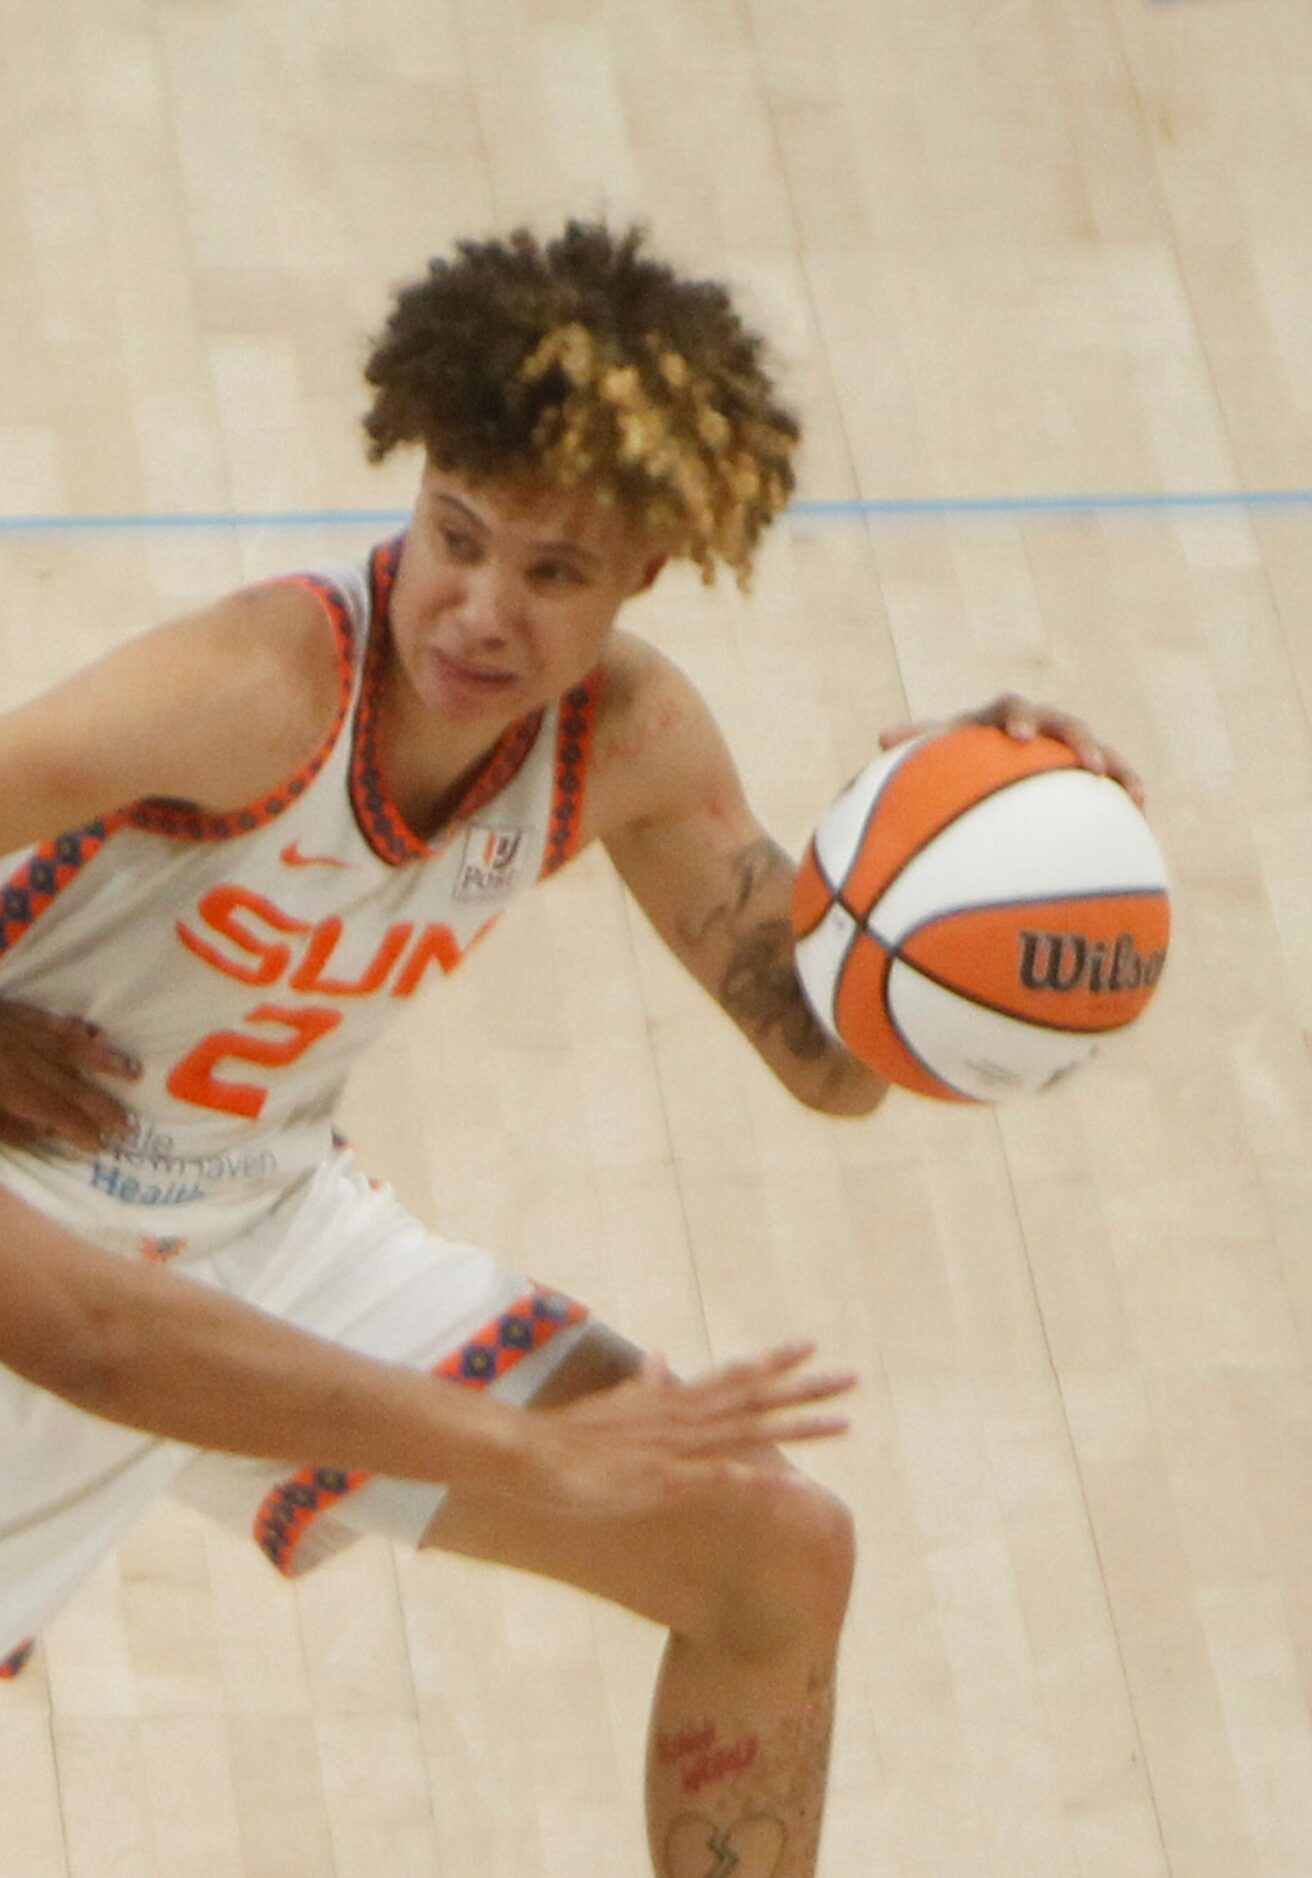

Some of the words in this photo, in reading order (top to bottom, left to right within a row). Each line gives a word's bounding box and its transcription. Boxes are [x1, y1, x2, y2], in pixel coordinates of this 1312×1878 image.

[175, 883, 502, 1000] SUN
[1015, 930, 1168, 994] Wilso
[165, 1002, 344, 1122] 2
